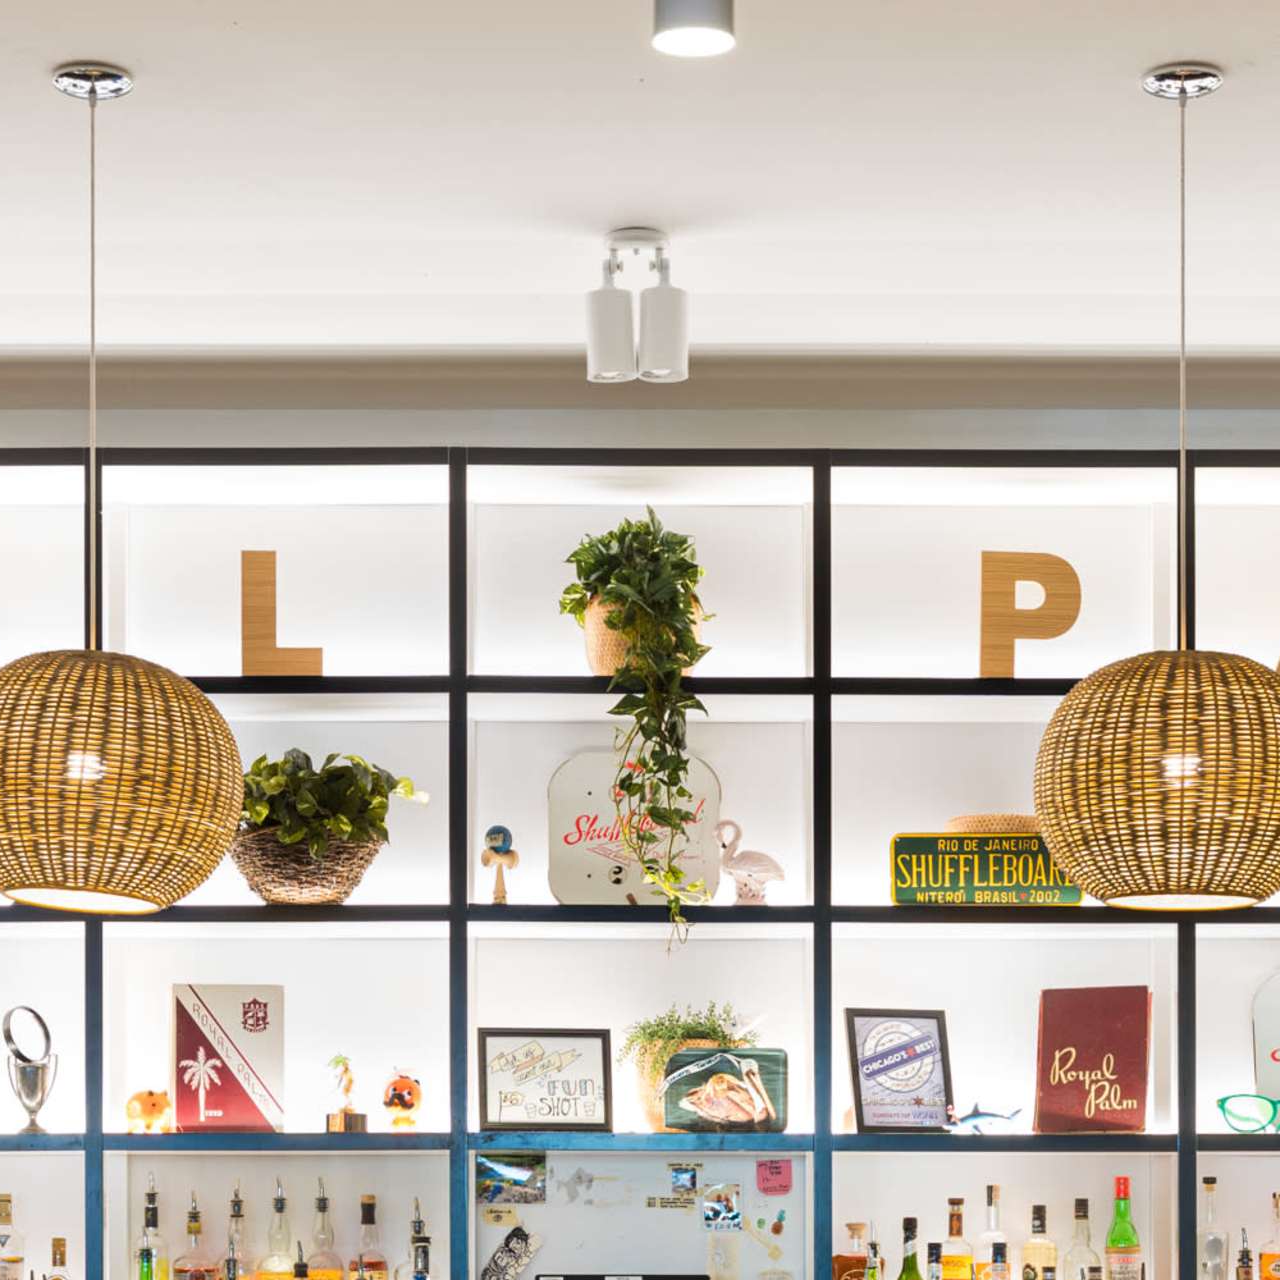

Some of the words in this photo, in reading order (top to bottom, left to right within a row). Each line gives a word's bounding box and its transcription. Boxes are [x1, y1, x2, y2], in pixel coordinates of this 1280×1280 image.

[937, 839, 959, 852] RIO
[963, 839, 980, 851] DE
[983, 839, 1039, 851] JANEIRO
[896, 853, 1075, 888] SHUFFLEBOAR
[974, 890, 1019, 903] BRASIL
[1029, 890, 1061, 902] 2002
[1050, 1047, 1118, 1090] Royal
[1084, 1081, 1138, 1118] Palm
